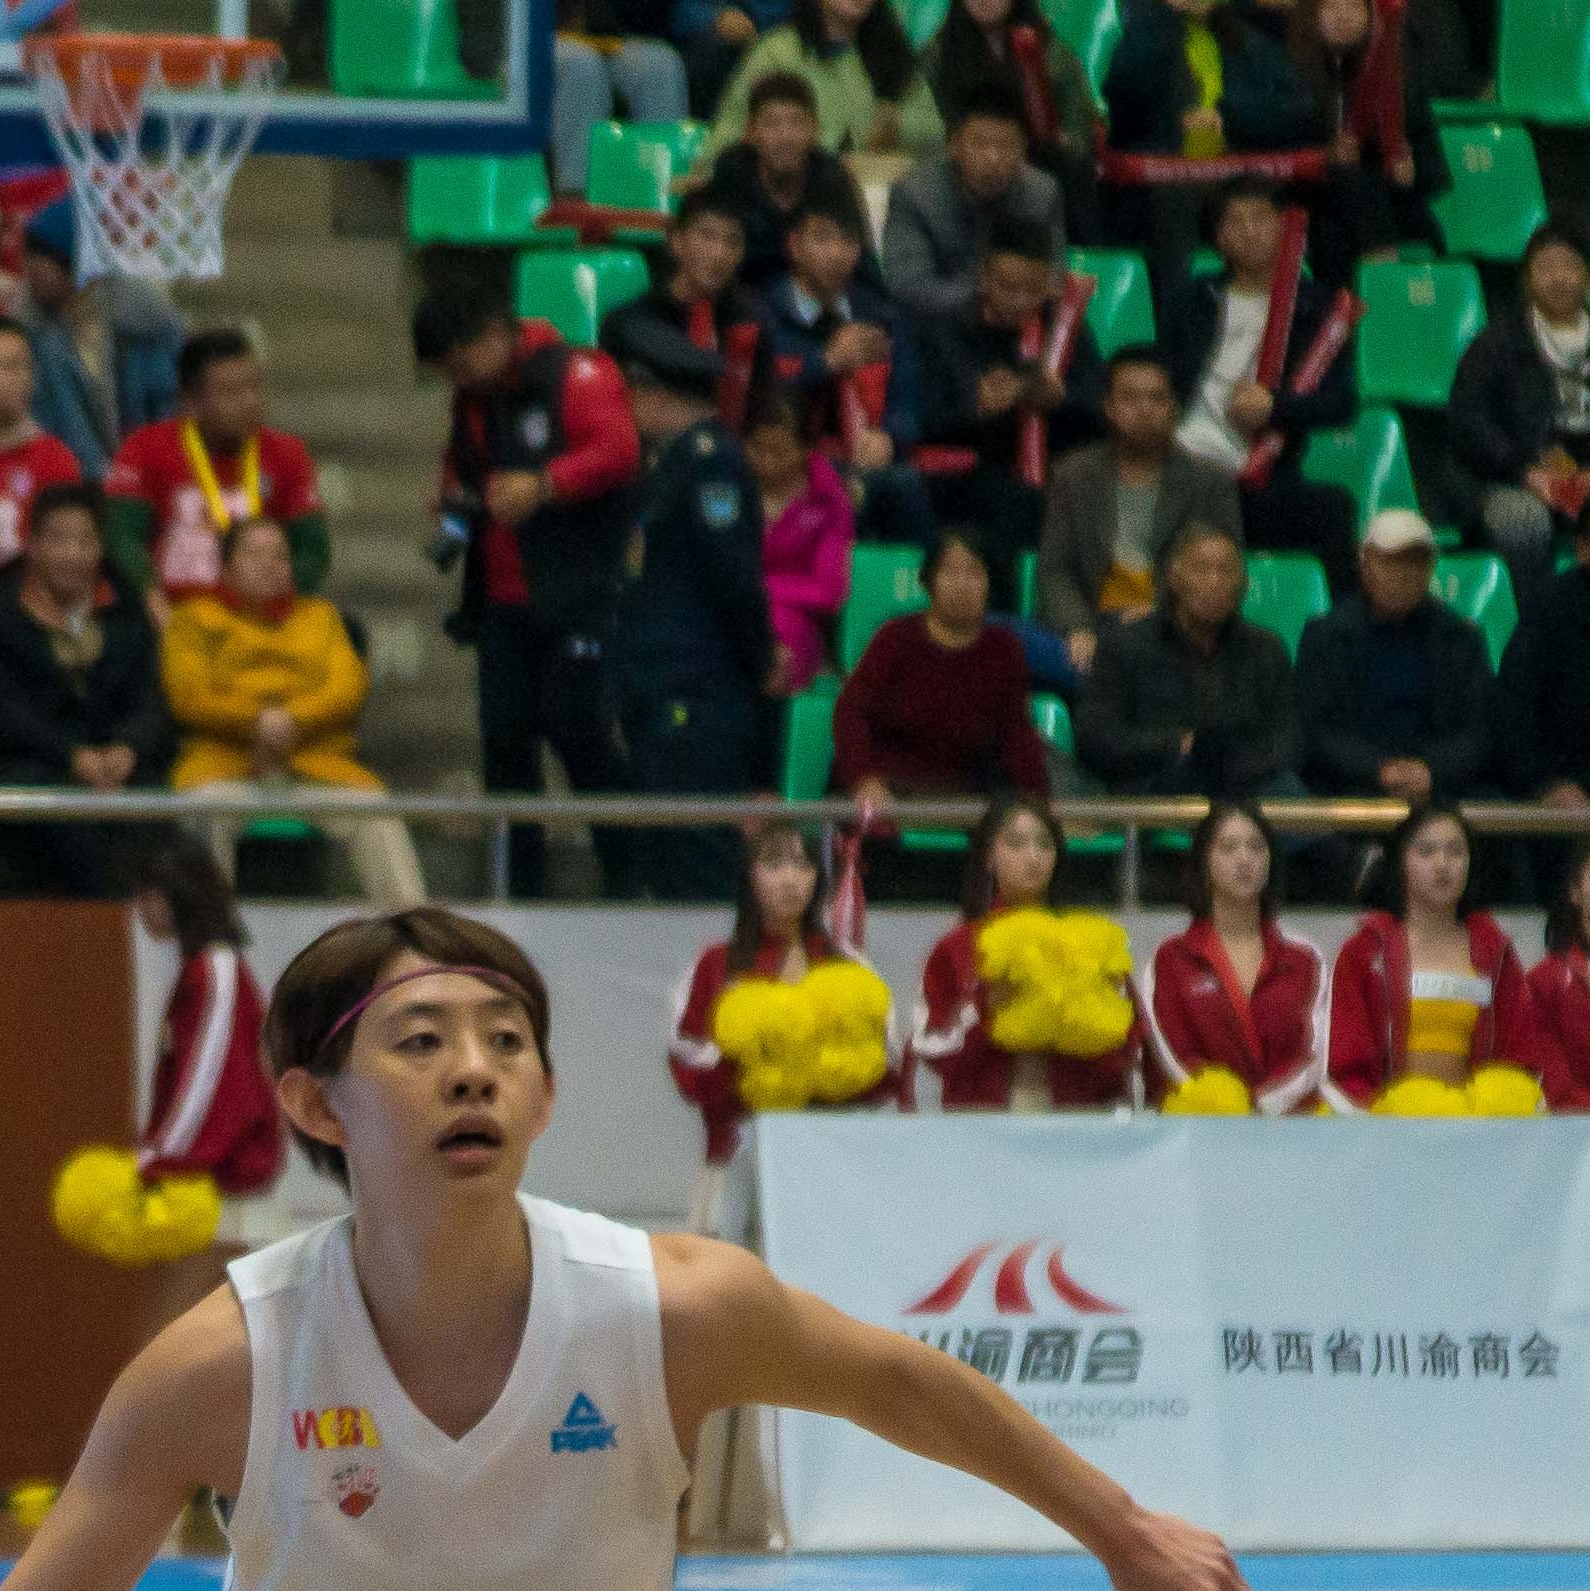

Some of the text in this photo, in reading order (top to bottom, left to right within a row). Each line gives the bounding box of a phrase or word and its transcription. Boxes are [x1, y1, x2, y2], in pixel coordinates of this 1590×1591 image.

[907, 1326, 1145, 1385] 渝商会
[1222, 1326, 1561, 1380] 陕西省川渝商会
